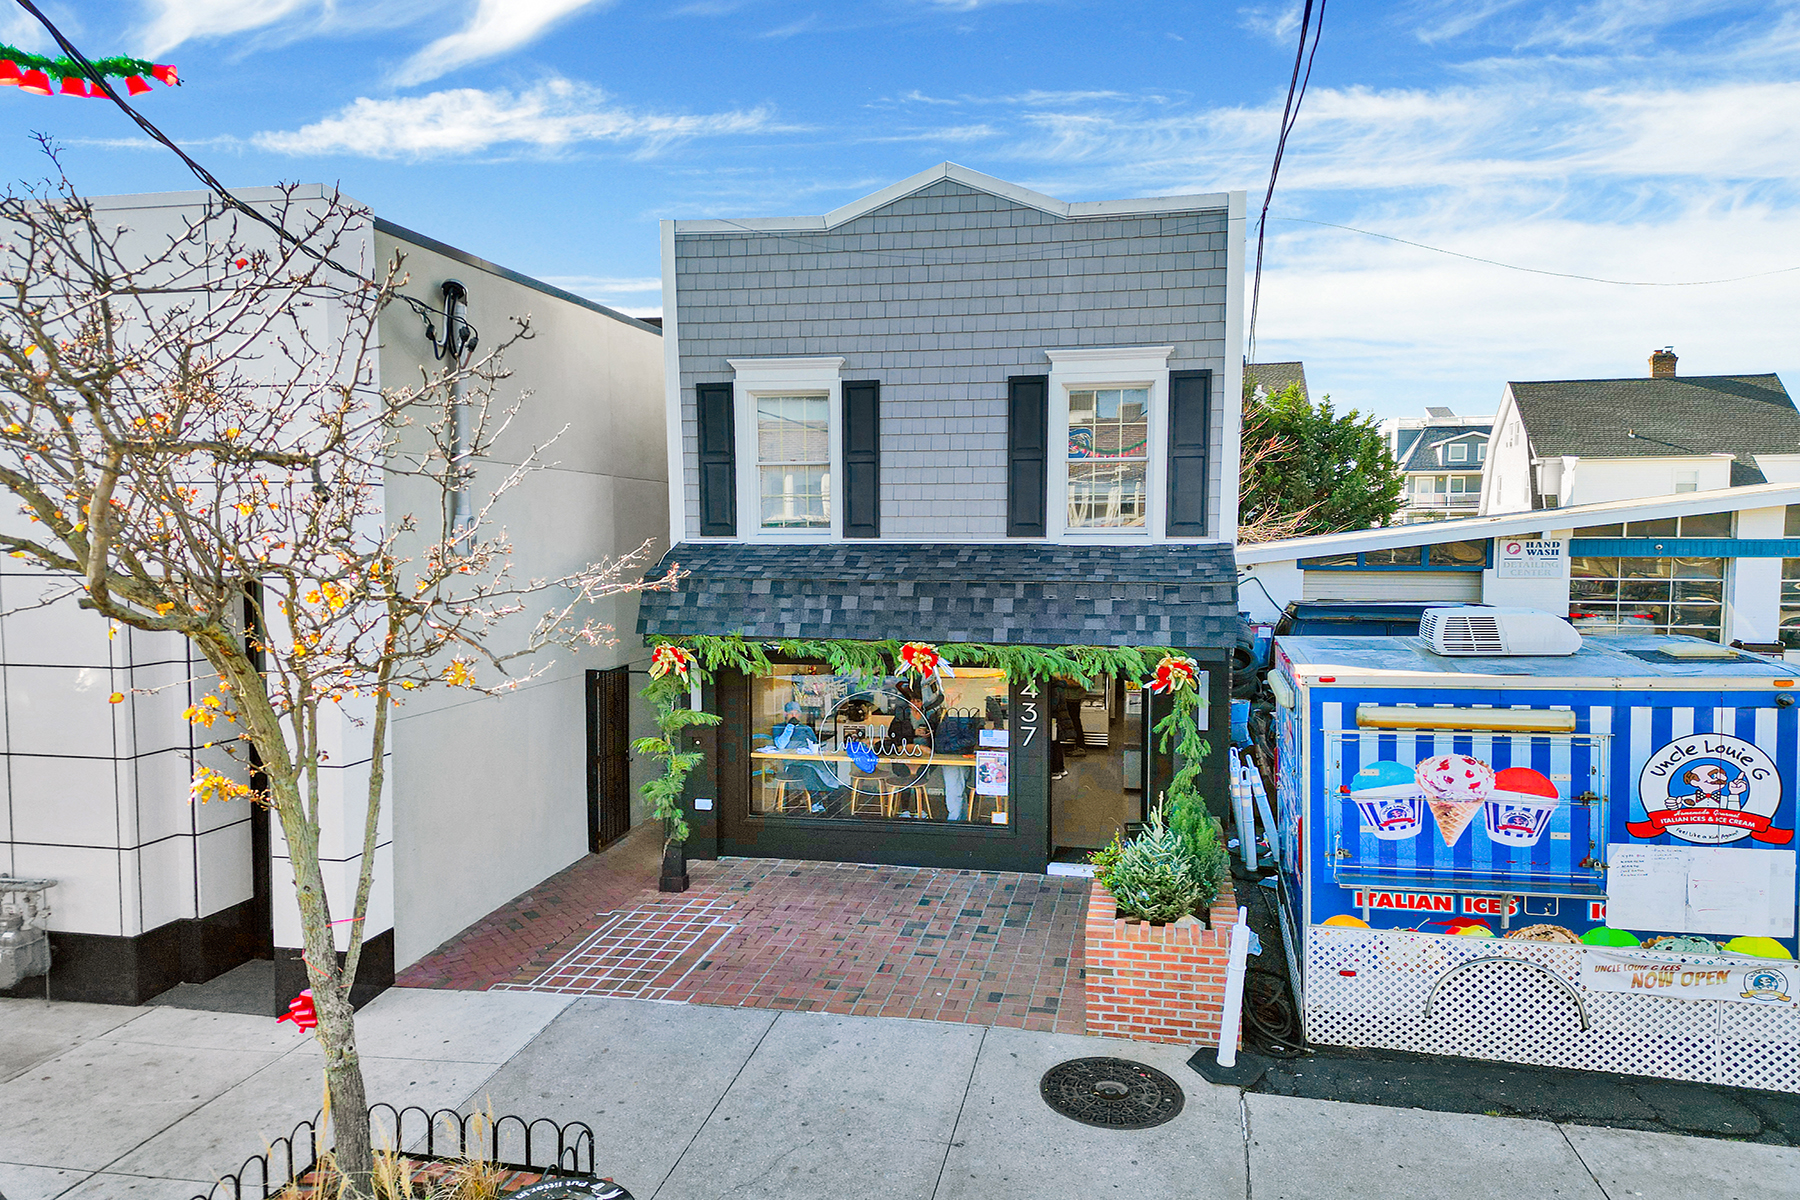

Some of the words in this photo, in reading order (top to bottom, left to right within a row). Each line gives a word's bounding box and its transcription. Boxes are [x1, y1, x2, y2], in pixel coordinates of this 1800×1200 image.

[1019, 679, 1039, 747] 437
[1650, 744, 1698, 777] Uncle
[1704, 740, 1754, 767] Louie
[1751, 767, 1771, 781] G
[1713, 809, 1741, 818] Gourmet
[1660, 816, 1689, 824] ITALIAN
[1728, 818, 1756, 828] CREAM
[1356, 891, 1452, 912] ITALIAN
[1464, 896, 1517, 916] ICES
[1594, 964, 1621, 973] UNCLE
[1623, 963, 1649, 972] LOUIE
[1631, 972, 1675, 989] NOW
[1680, 969, 1731, 988] OPEN
[565, 1180, 589, 1188] Put
